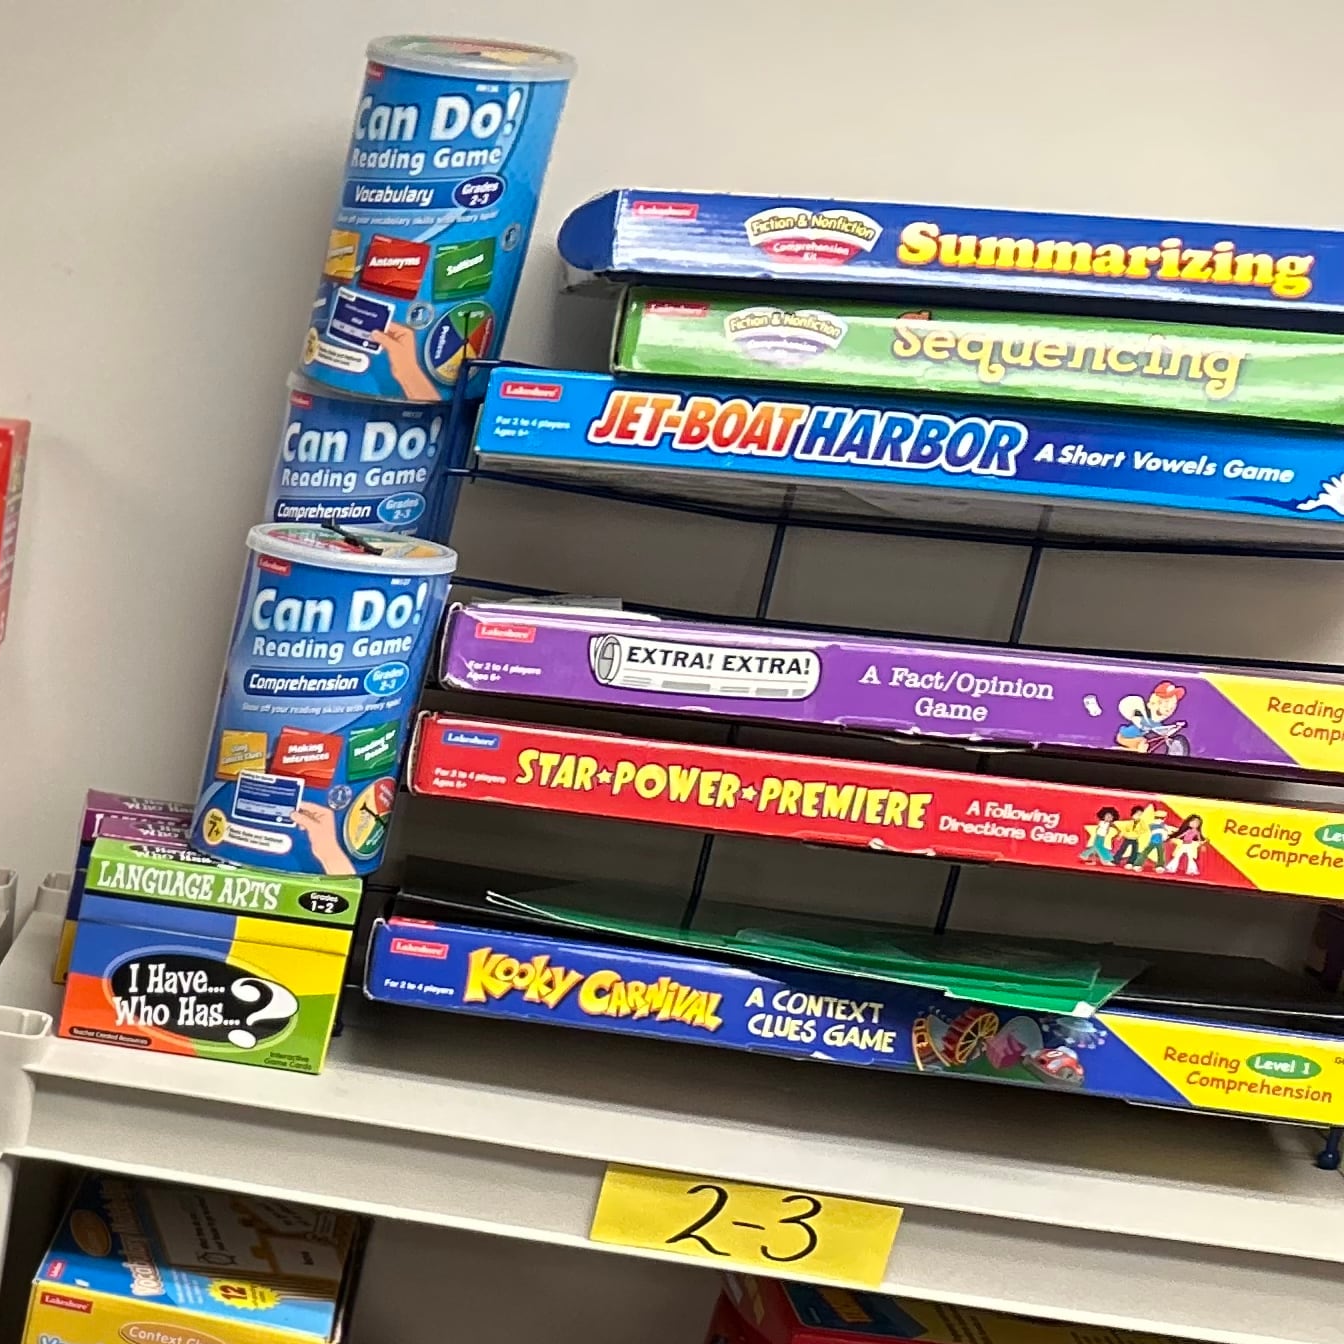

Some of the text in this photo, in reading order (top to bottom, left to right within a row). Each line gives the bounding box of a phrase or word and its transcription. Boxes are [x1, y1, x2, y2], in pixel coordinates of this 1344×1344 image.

[354, 185, 434, 207] Vocabulary
[750, 214, 875, 240] Fiction & Nonfiction
[897, 222, 1314, 298] Summarizing
[893, 318, 1246, 398] Sequencing
[593, 392, 1026, 476] JET-BOAT HARBOR
[1034, 444, 1295, 483] A Short Vowels Game
[252, 583, 425, 632] Can Do!
[252, 635, 412, 664] Reading Game
[626, 646, 810, 675] EXTRA! EXTRA!
[249, 674, 359, 693] Comprehension
[859, 666, 1054, 701] A Fact/Opinion
[915, 699, 988, 722] Game
[96, 859, 281, 911] LANGUAGE ARTS
[309, 900, 334, 914] 1-2
[129, 963, 226, 995] I Have...
[113, 996, 241, 1027] Who Has...
[1186, 1071, 1333, 1104] Comprehension
[665, 1184, 822, 1263] 2-3
